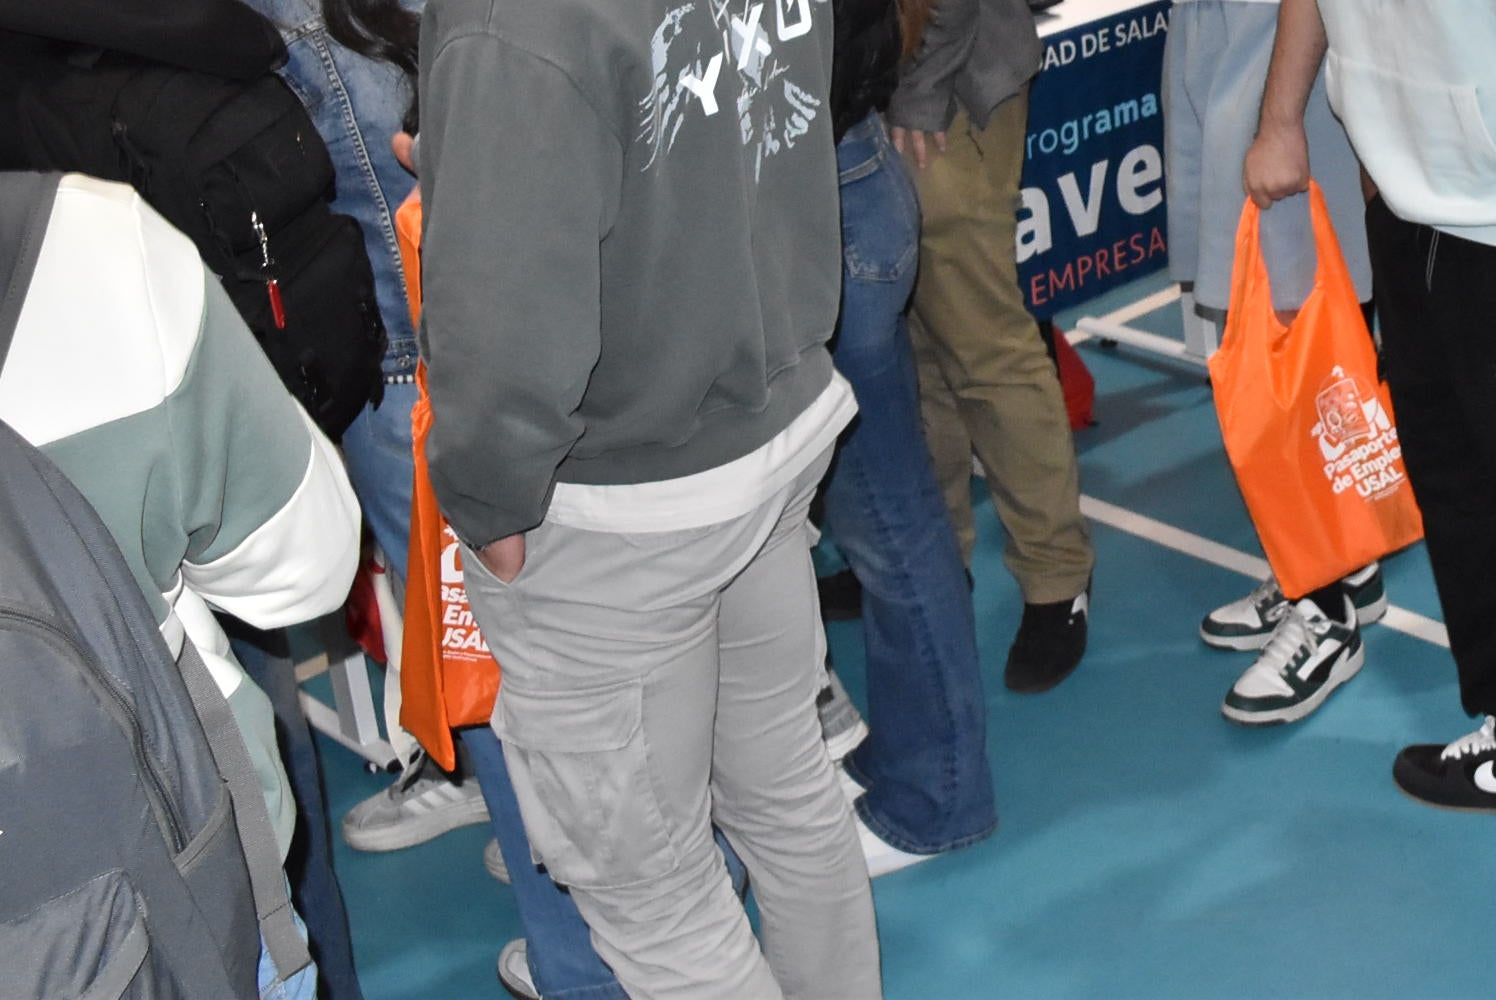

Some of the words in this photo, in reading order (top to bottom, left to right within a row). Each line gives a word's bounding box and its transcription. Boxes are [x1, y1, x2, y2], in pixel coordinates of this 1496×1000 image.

[1039, 39, 1076, 71] AD
[1081, 28, 1111, 58] DE
[1115, 8, 1172, 47] SALA
[1027, 92, 1157, 159] rograma
[1031, 226, 1166, 306] EMPRESA
[1332, 475, 1354, 494] de
[1350, 446, 1401, 480] Emple
[1355, 466, 1405, 496] USAL
